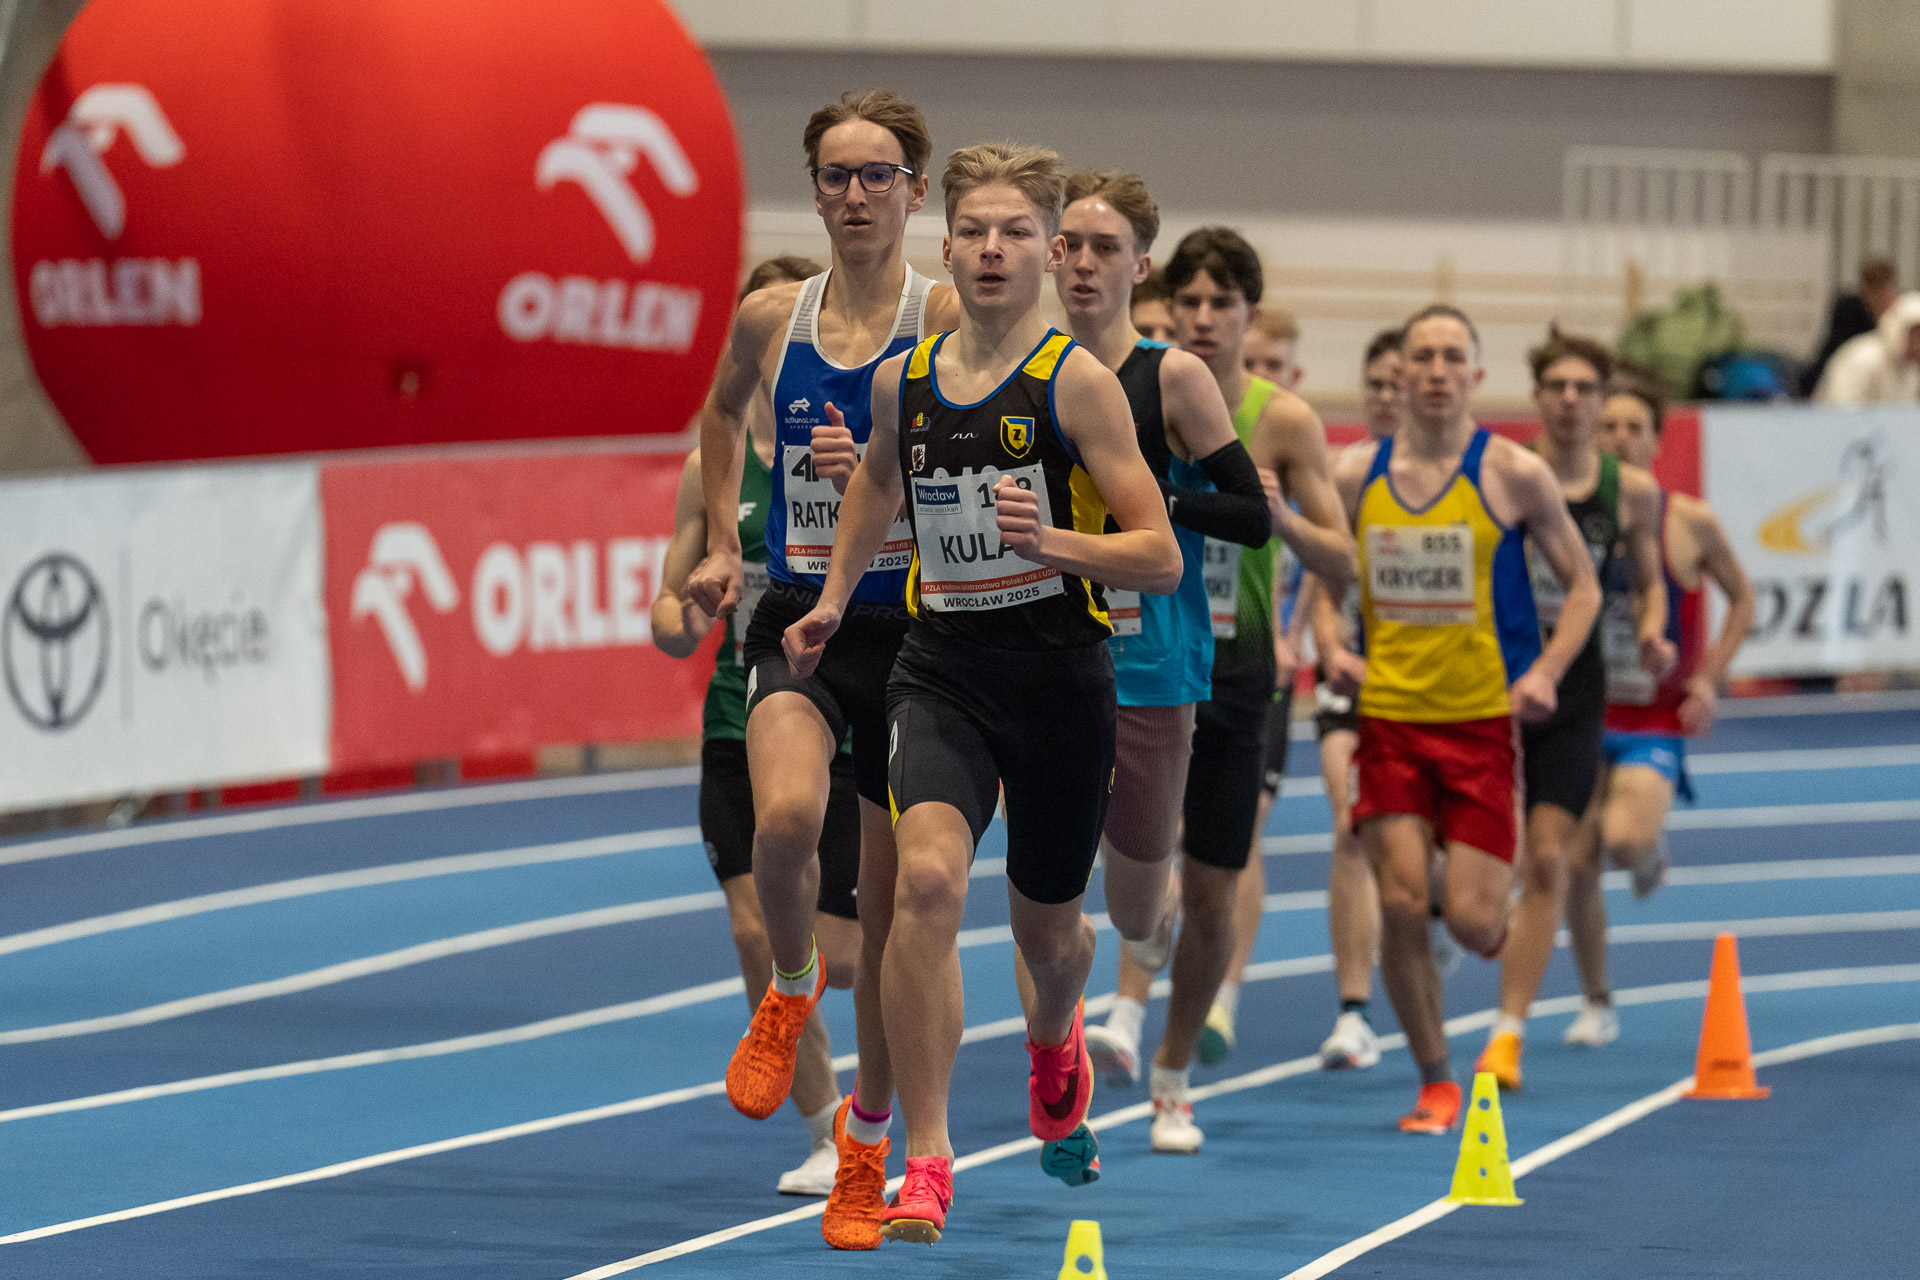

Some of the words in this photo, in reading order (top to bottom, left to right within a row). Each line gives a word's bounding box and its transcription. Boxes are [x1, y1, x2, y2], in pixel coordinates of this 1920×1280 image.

[30, 257, 202, 328] ORLEN
[497, 270, 703, 354] ORLEN
[878, 555, 909, 568] 2025
[925, 584, 941, 592] PZLA
[1001, 577, 1024, 587] Polski
[1024, 574, 1038, 582] U18
[1042, 568, 1057, 577] U20
[1377, 567, 1463, 590] KRYGER
[943, 595, 1004, 608] WROCŁAW
[1007, 586, 1040, 603] 2025
